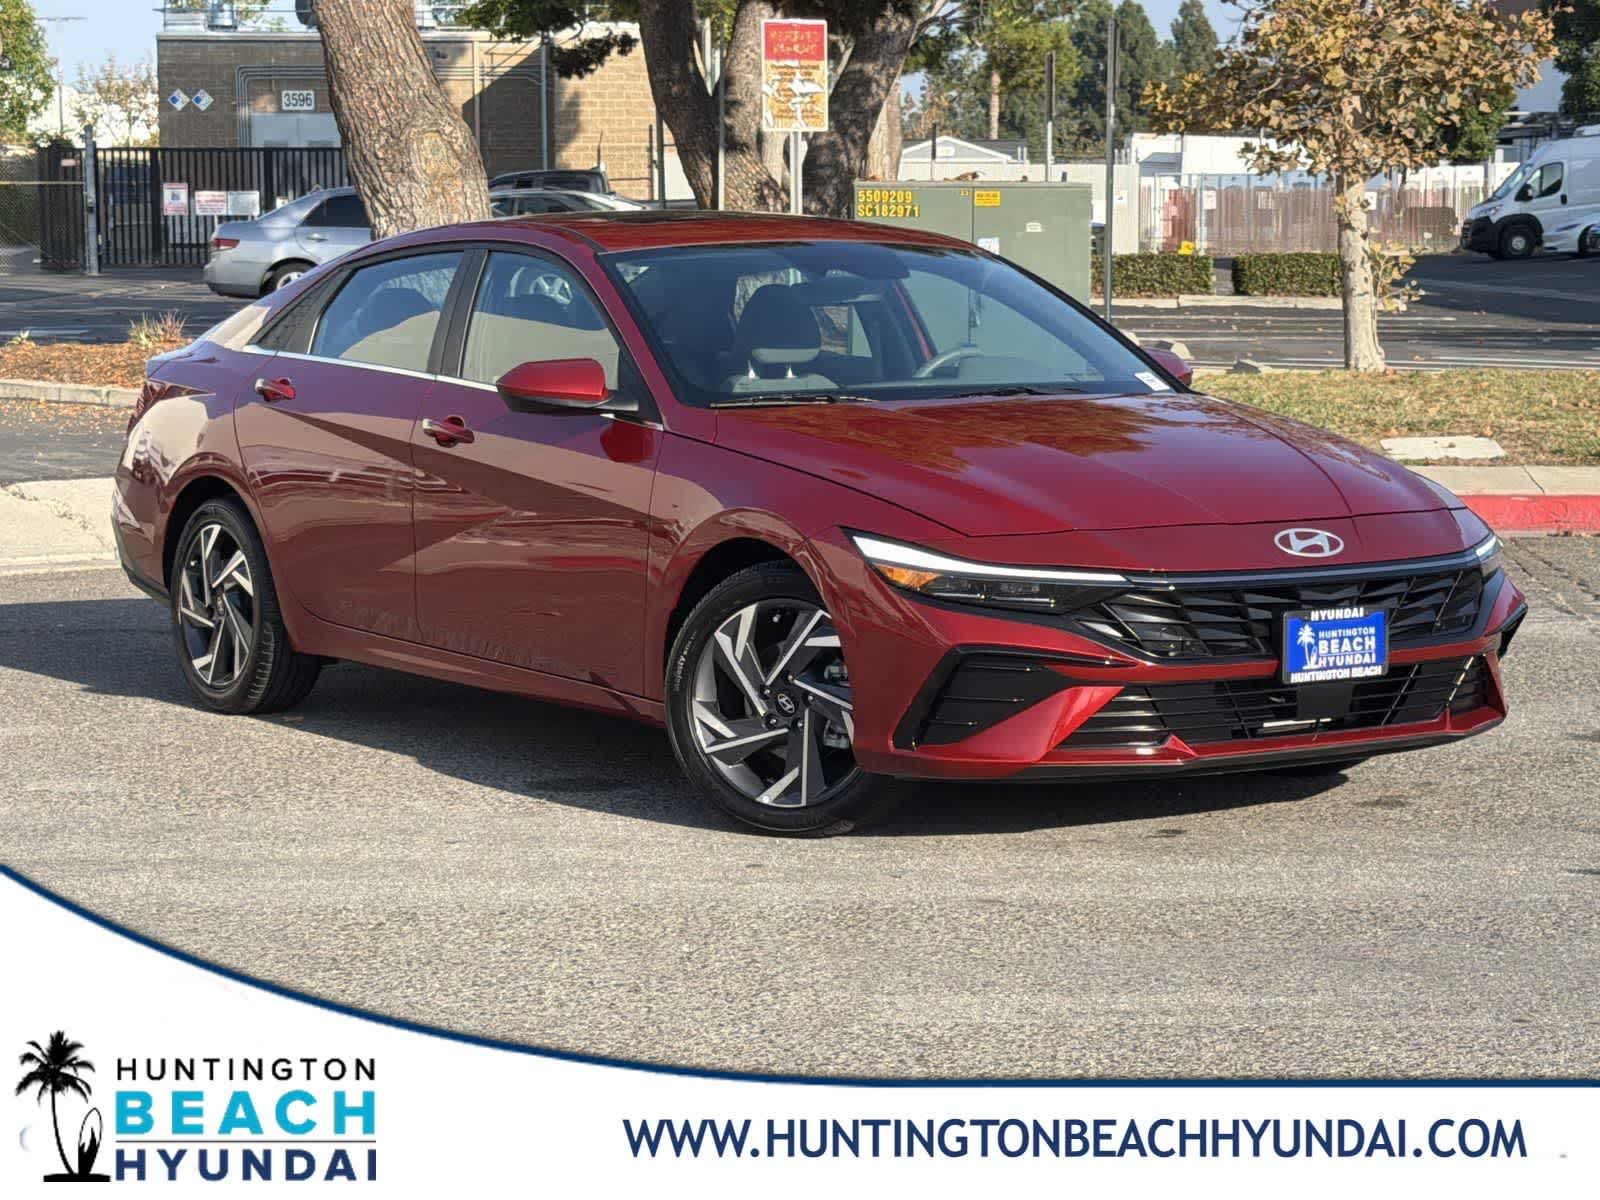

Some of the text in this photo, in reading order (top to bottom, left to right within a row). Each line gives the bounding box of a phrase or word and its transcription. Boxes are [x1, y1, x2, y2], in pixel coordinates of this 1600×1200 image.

[284, 92, 313, 107] 3596
[857, 190, 913, 203] 5509209
[1310, 607, 1364, 621] HYUNDAI
[1318, 627, 1376, 639] HUNTINGTON
[1318, 635, 1376, 654] BEACH
[1318, 653, 1377, 667] HYUNDAI
[1290, 665, 1382, 683] HUNTINGTON BEACH
